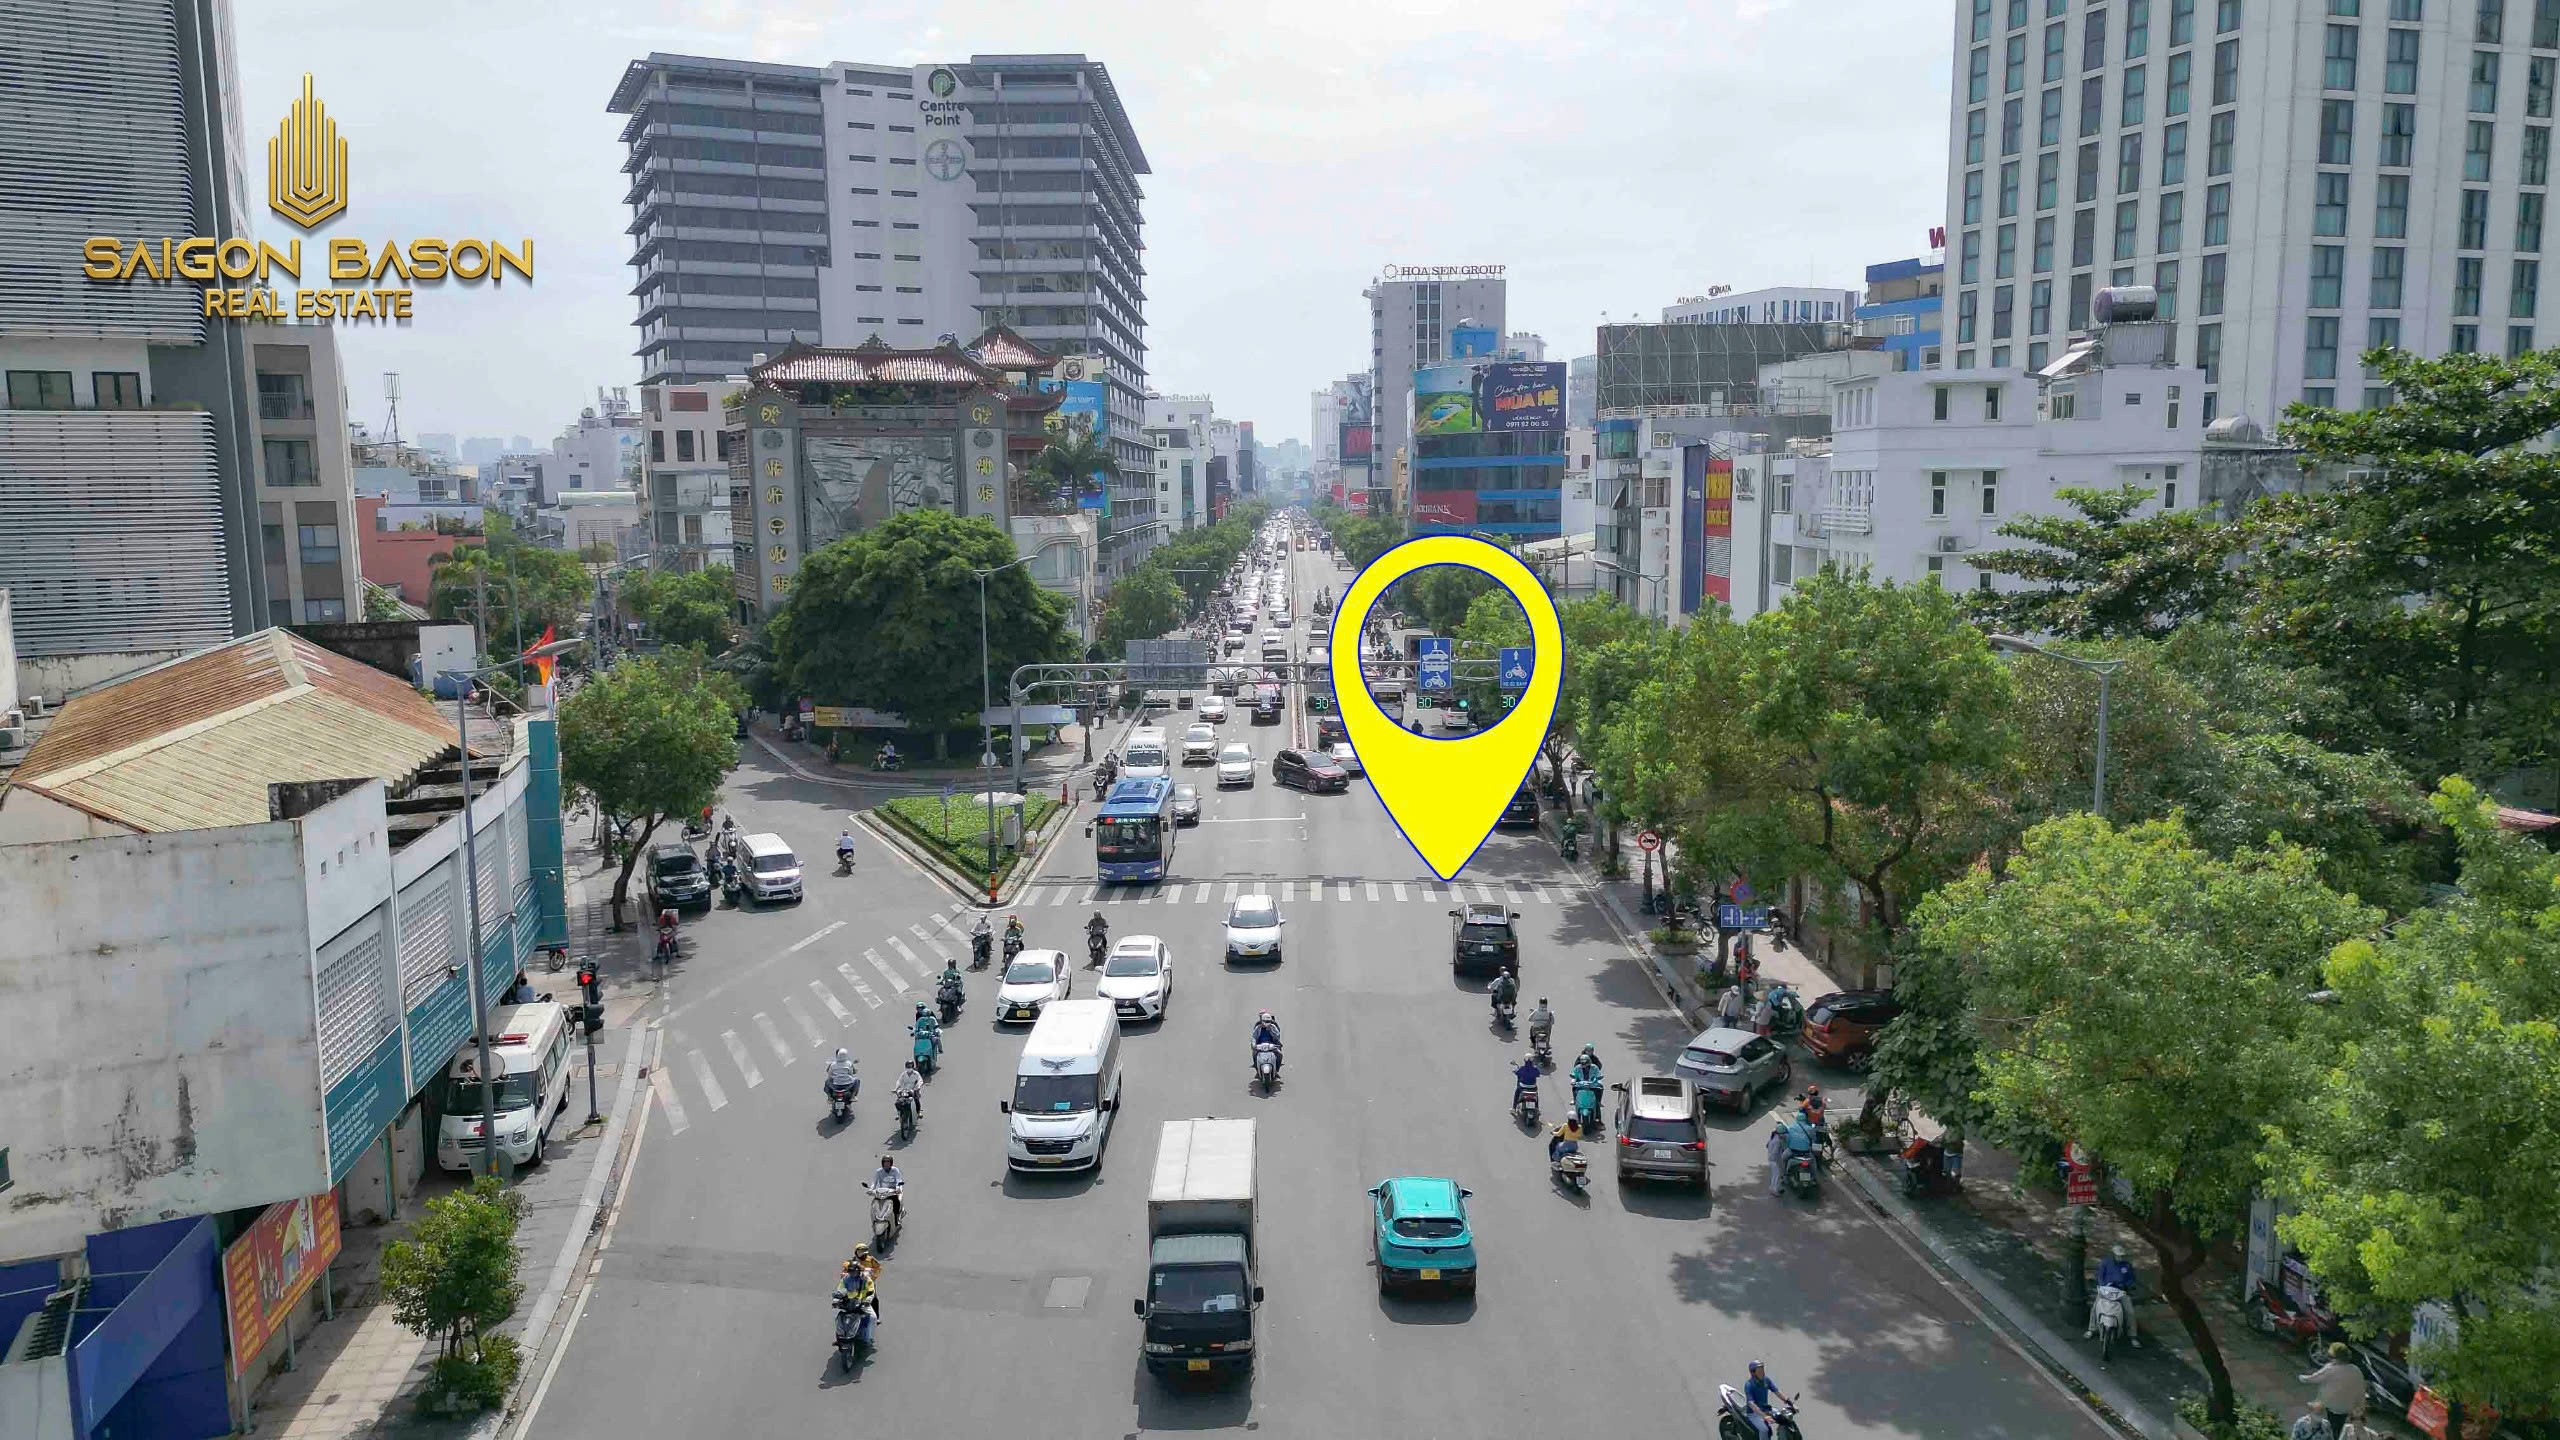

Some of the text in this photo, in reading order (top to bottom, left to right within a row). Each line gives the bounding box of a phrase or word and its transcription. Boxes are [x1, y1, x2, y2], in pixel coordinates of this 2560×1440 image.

[920, 100, 965, 112] Centre
[925, 114, 961, 126] Point
[1401, 264, 1506, 276] HOA SEN GROUP
[1315, 698, 1329, 709] 30
[1417, 697, 1432, 708] 30
[1501, 696, 1516, 708] 30
